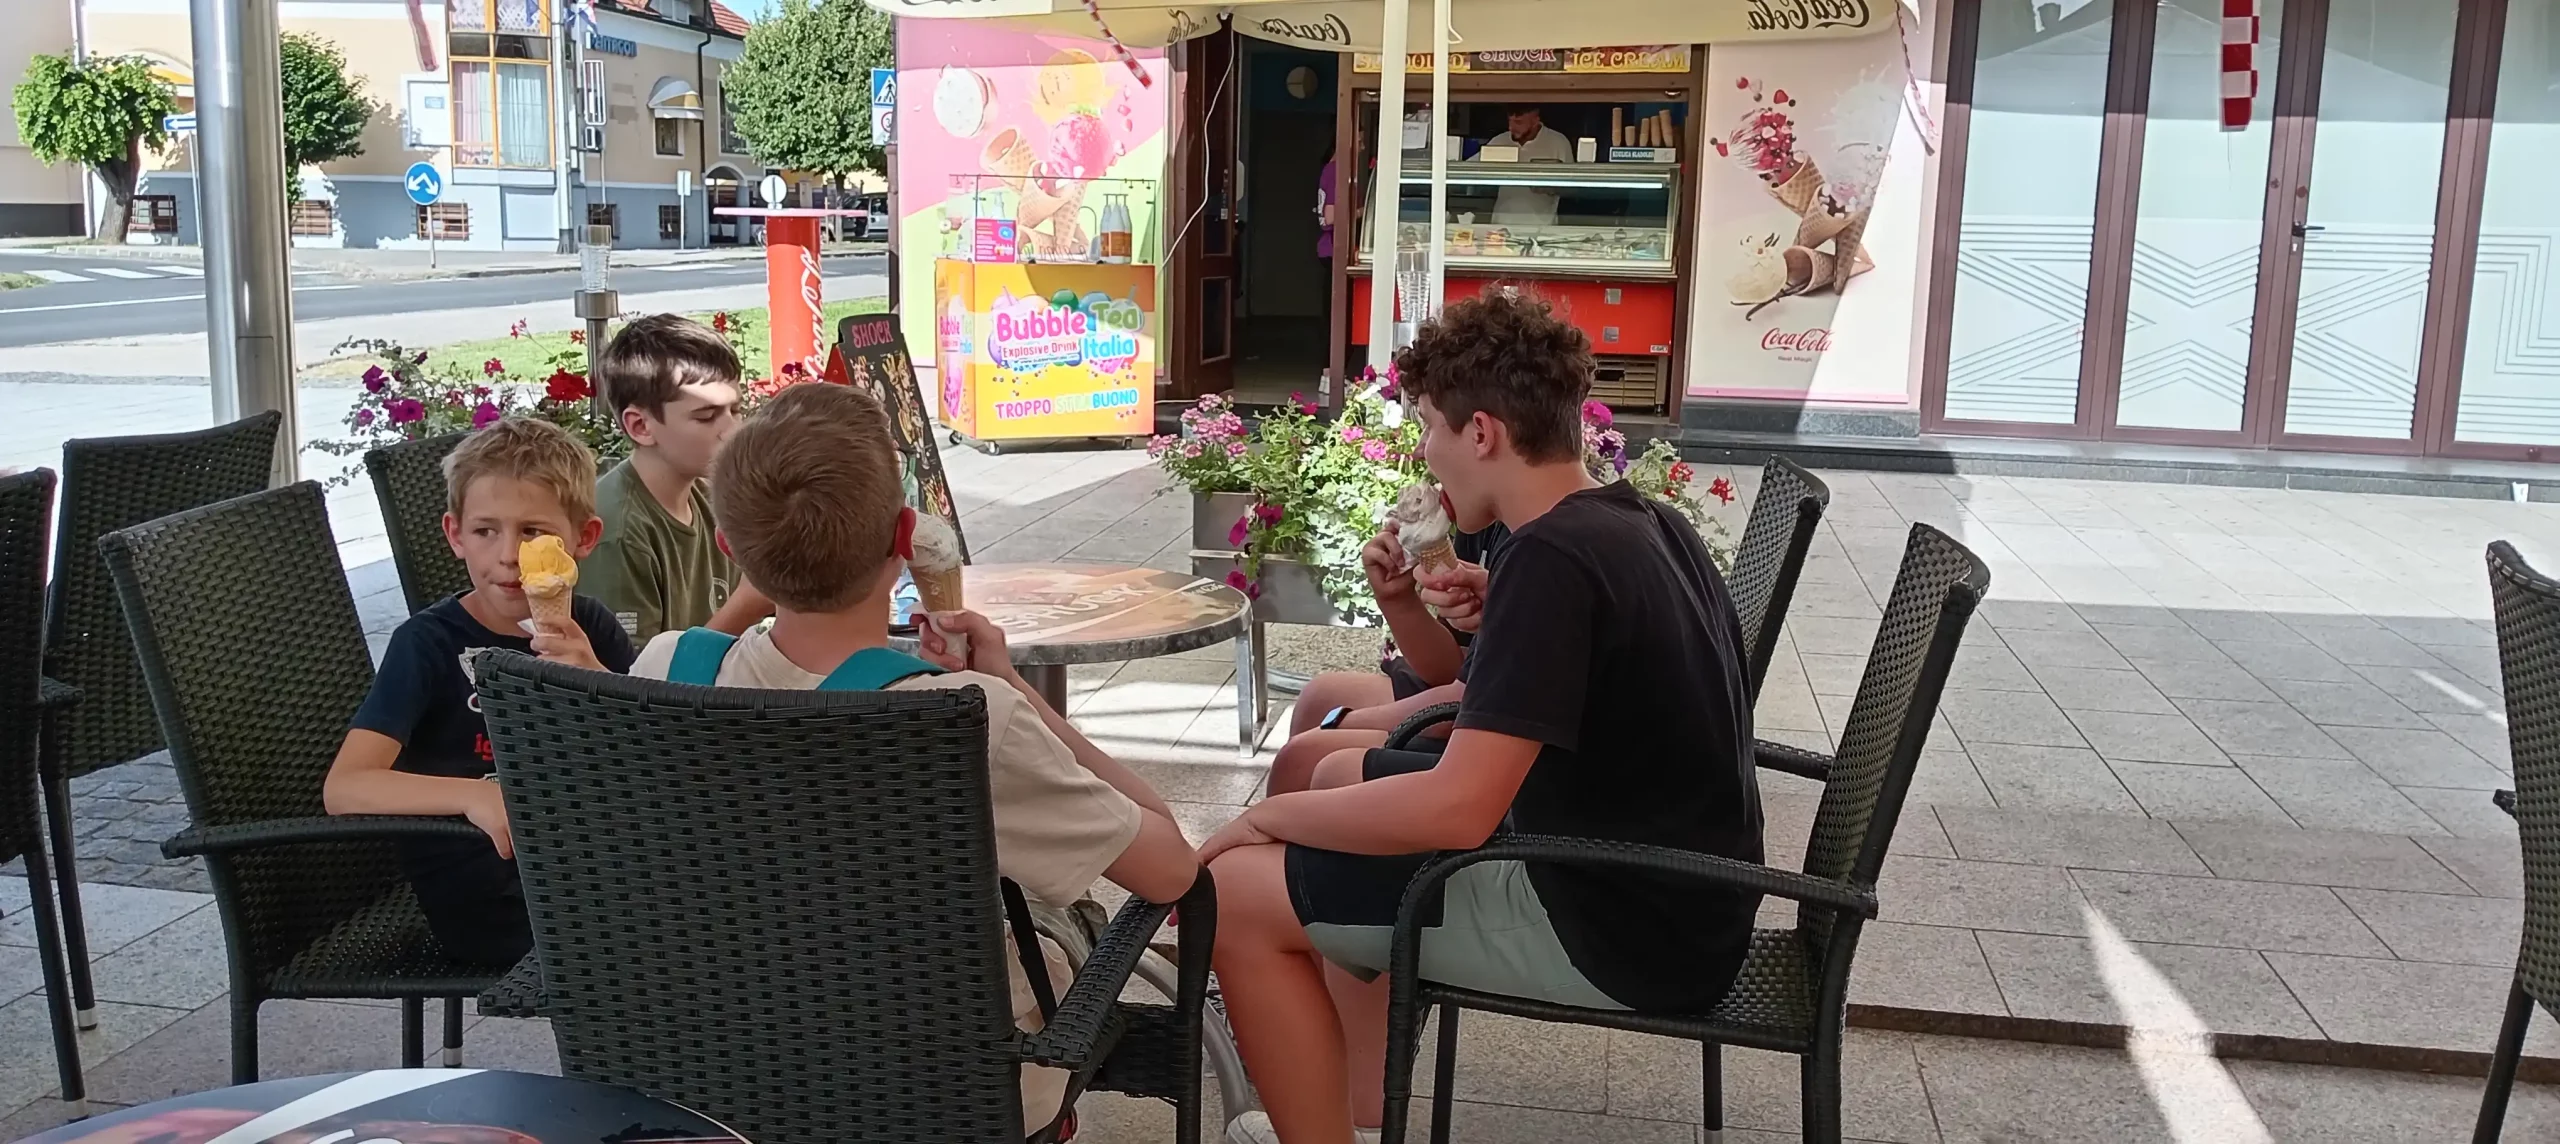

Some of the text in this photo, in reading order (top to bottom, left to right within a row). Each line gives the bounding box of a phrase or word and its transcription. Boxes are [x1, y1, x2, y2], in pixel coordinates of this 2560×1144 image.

[1479, 47, 1557, 63] SHOCK
[1572, 50, 1686, 70] ICE CREAM
[997, 303, 1138, 342] Bubble Tea
[852, 320, 894, 348] SHOCK
[1003, 345, 1049, 359] Explosive
[1051, 342, 1077, 354] Drink
[1084, 335, 1134, 359] Italia
[995, 399, 1051, 419] TROPPO
